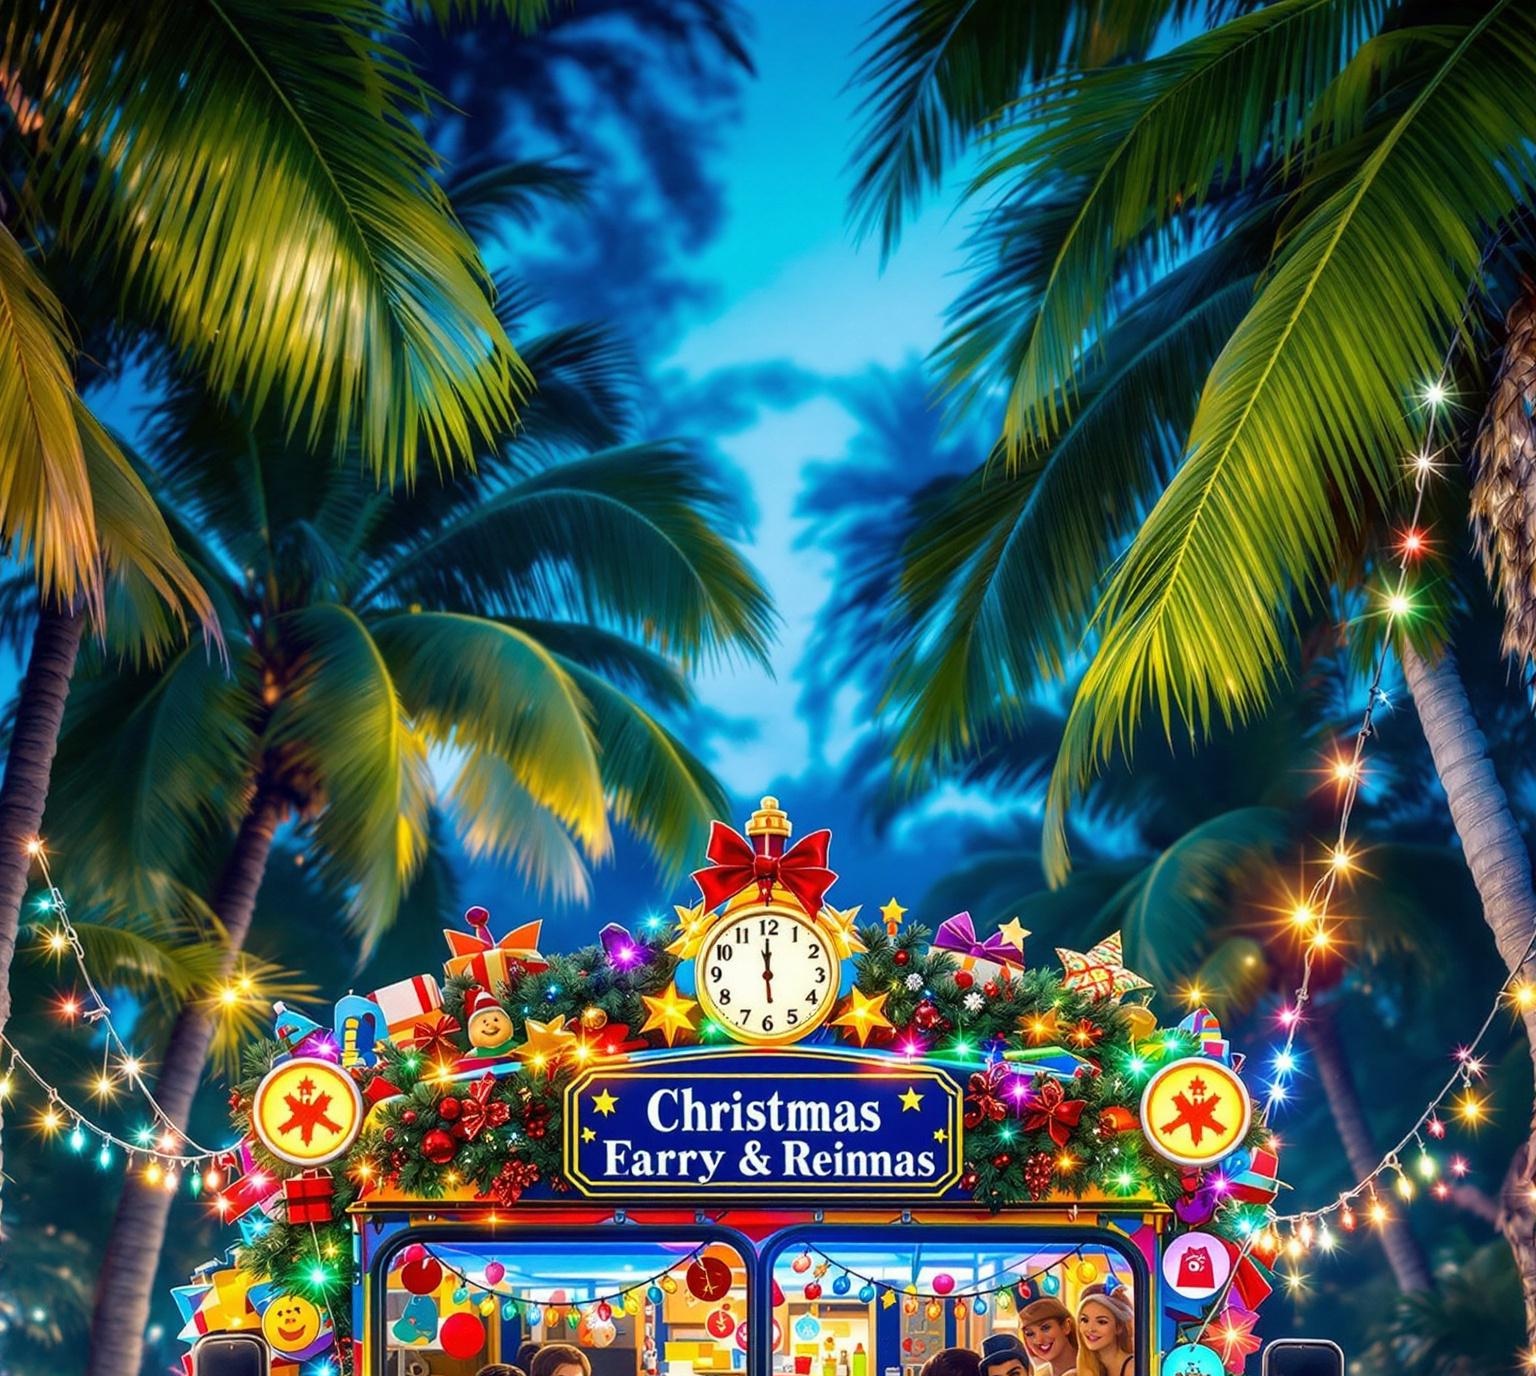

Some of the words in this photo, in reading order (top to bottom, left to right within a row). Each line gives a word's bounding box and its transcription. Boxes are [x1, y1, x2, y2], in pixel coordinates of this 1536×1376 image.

[735, 927, 749, 943] 11
[760, 920, 778, 936] 12
[792, 926, 798, 943] 1
[717, 944, 732, 961] 10
[808, 944, 819, 959] 2
[711, 967, 722, 983] 9
[815, 967, 825, 983] 3
[719, 989, 731, 1005] 8
[805, 989, 818, 1005] 4
[740, 1009, 751, 1025] 7
[762, 1015, 773, 1031] 6
[787, 1009, 798, 1024] 5
[647, 1087, 882, 1133] Christmas
[603, 1140, 726, 1184] Earry
[738, 1140, 772, 1177] &
